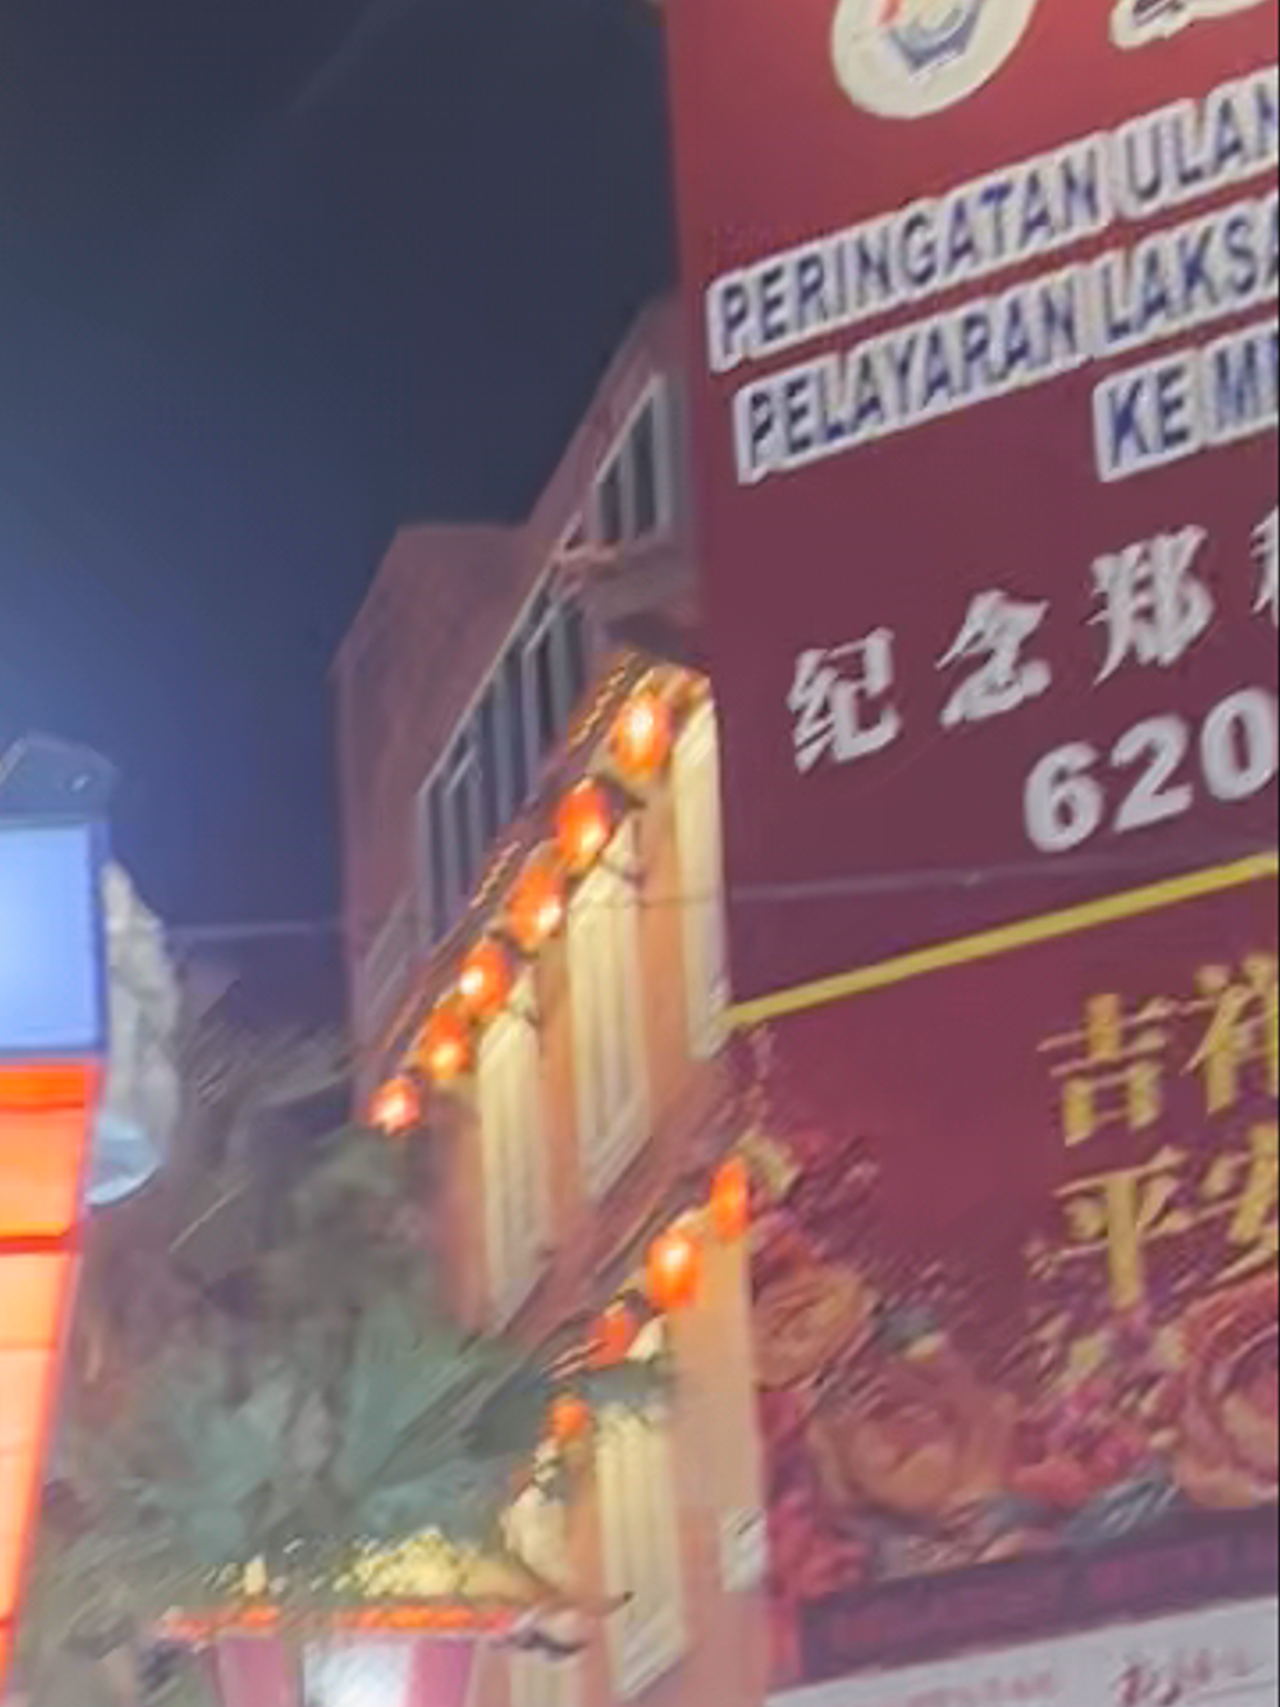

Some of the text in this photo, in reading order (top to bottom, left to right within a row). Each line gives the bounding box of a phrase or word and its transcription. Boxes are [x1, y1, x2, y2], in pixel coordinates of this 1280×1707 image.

[718, 145, 1100, 359] PERINGATAN
[746, 273, 1080, 465] PELAYARAN
[1106, 323, 1278, 471] KE M
[785, 505, 1278, 775] 纪念郑
